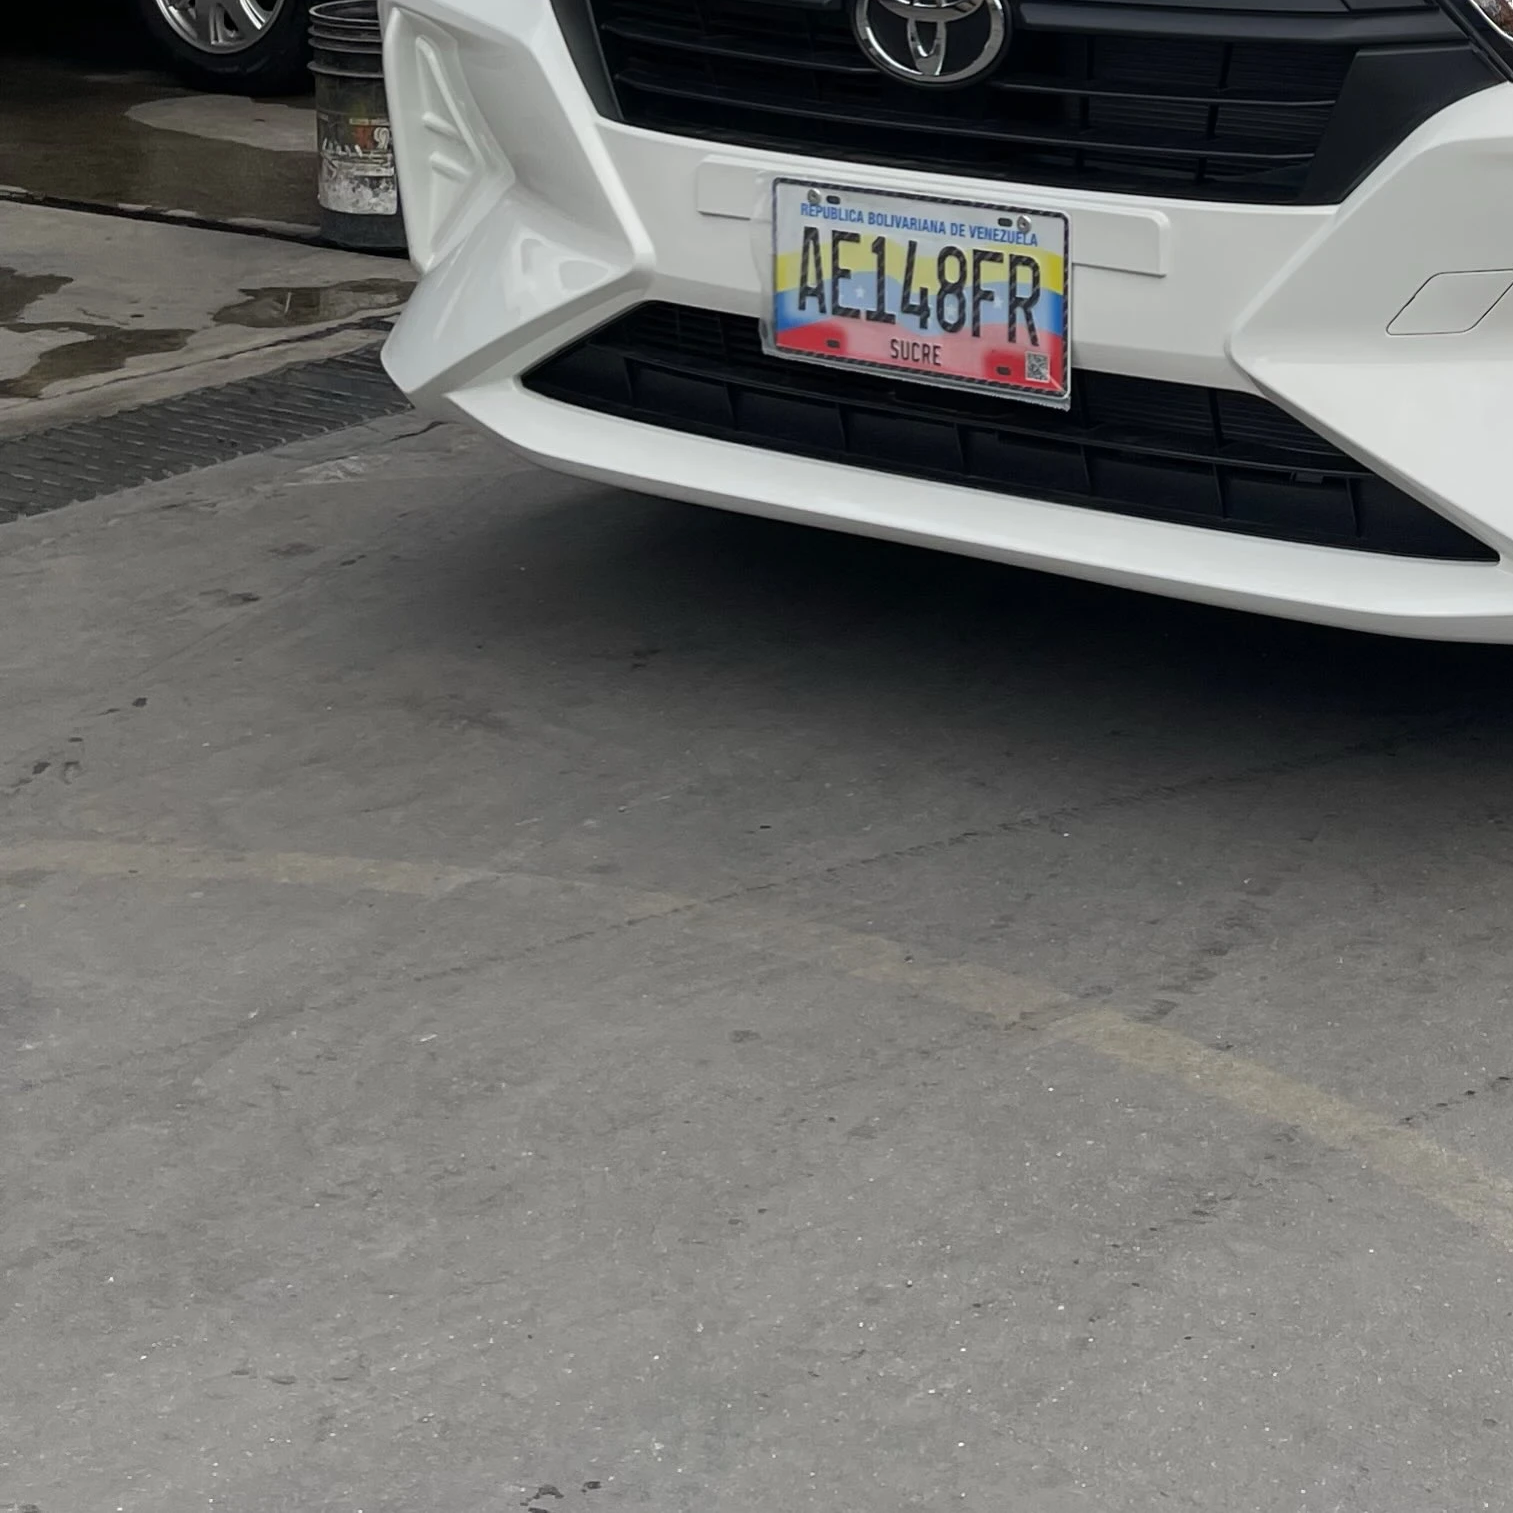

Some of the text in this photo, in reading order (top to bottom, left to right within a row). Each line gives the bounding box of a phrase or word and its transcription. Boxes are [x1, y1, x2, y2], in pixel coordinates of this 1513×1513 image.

[800, 202, 1038, 247] REPUBLICA BOLIVARIANA DE VENEZUELA
[798, 226, 1040, 347] AE148FR
[890, 337, 942, 366] SUCRE
